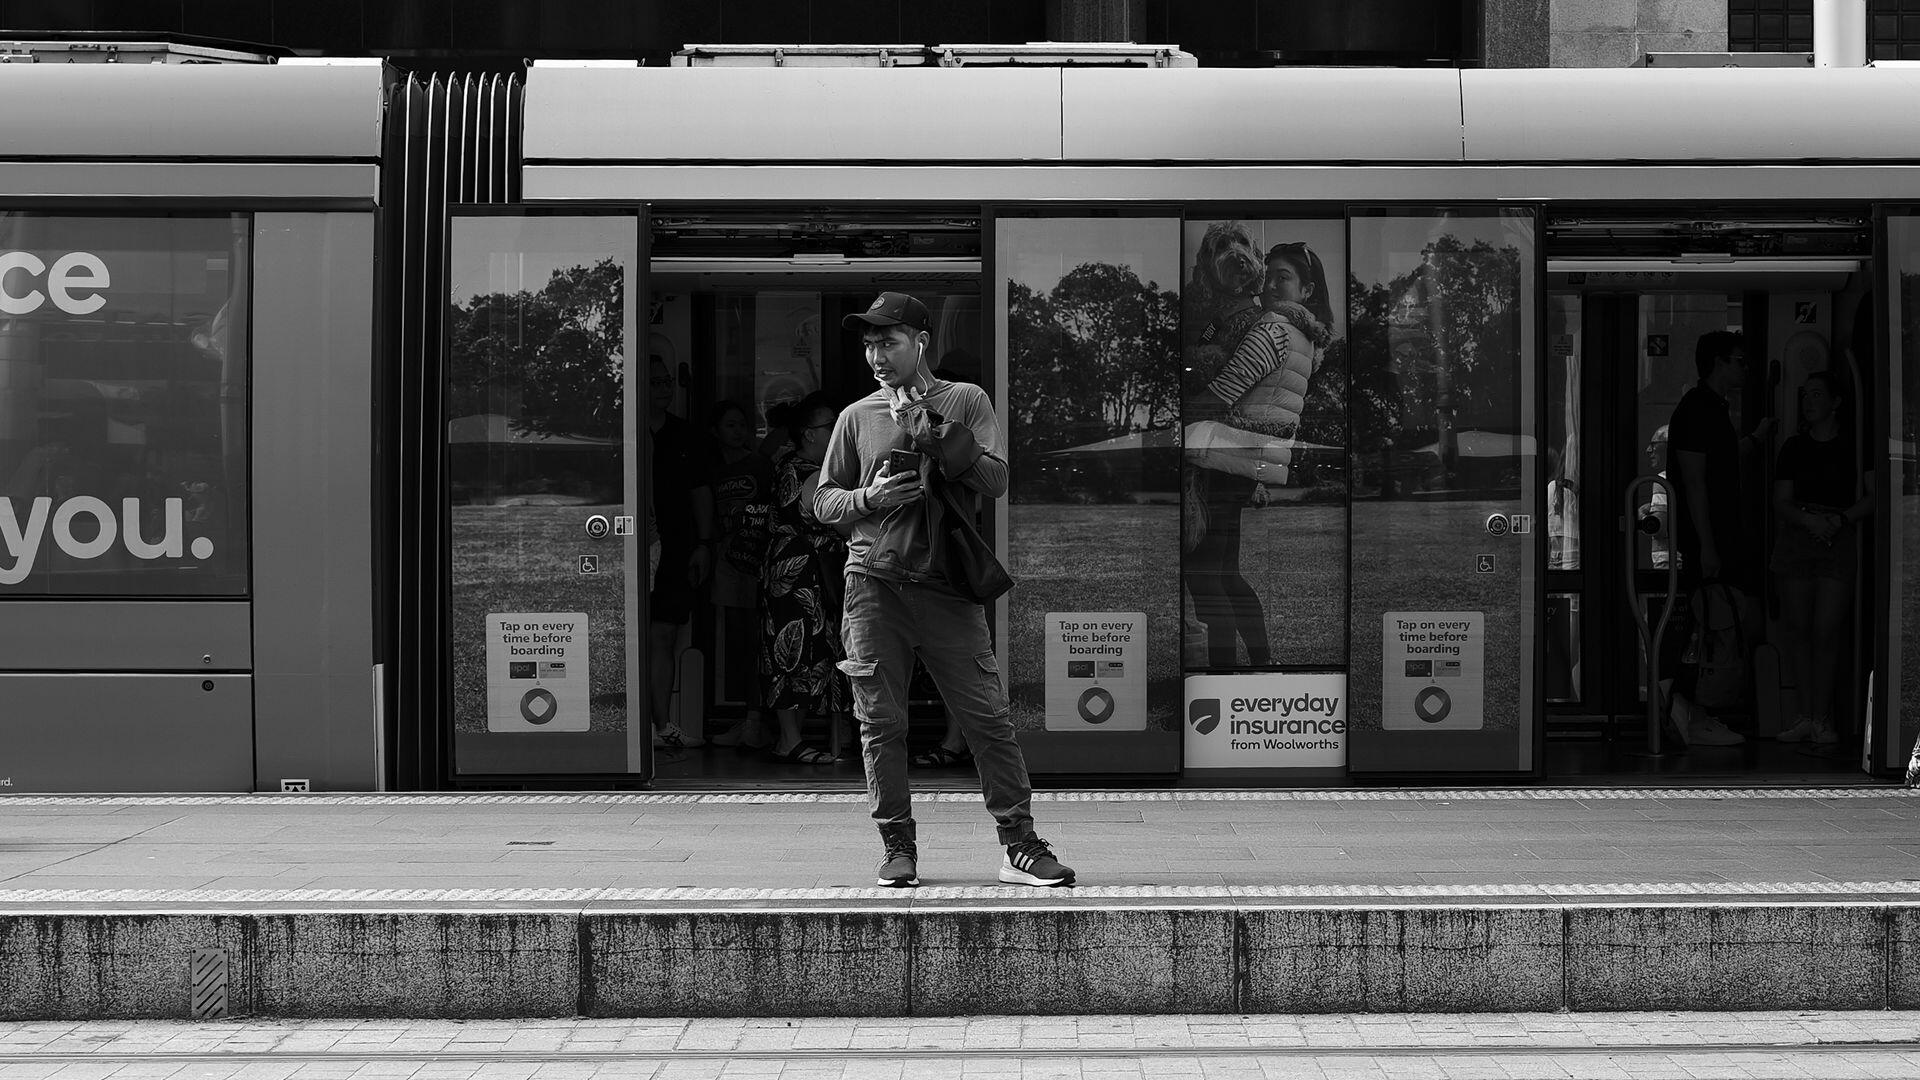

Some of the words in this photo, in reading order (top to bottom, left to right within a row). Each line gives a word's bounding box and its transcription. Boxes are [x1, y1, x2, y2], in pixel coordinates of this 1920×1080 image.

[0, 496, 214, 585] you.
[500, 622, 520, 633] Tap
[523, 623, 538, 631] on
[542, 623, 574, 633] every
[1059, 621, 1079, 632] Tap
[1082, 622, 1097, 630] on
[1101, 622, 1133, 633] every
[1397, 620, 1416, 631] Tap
[1420, 622, 1435, 630] on
[1438, 621, 1470, 632] every
[503, 634, 529, 643] time
[533, 632, 571, 643] before
[1062, 633, 1088, 642] time
[1091, 632, 1130, 643] before
[1399, 632, 1425, 641] time
[1429, 631, 1467, 642] before
[511, 645, 564, 657] boarding
[1070, 645, 1122, 656] boarding
[1407, 644, 1459, 655] boarding
[1231, 693, 1338, 717] everyday
[1231, 714, 1346, 734] insurance
[1231, 739, 1260, 749] from
[1264, 739, 1338, 749] Woolworths
